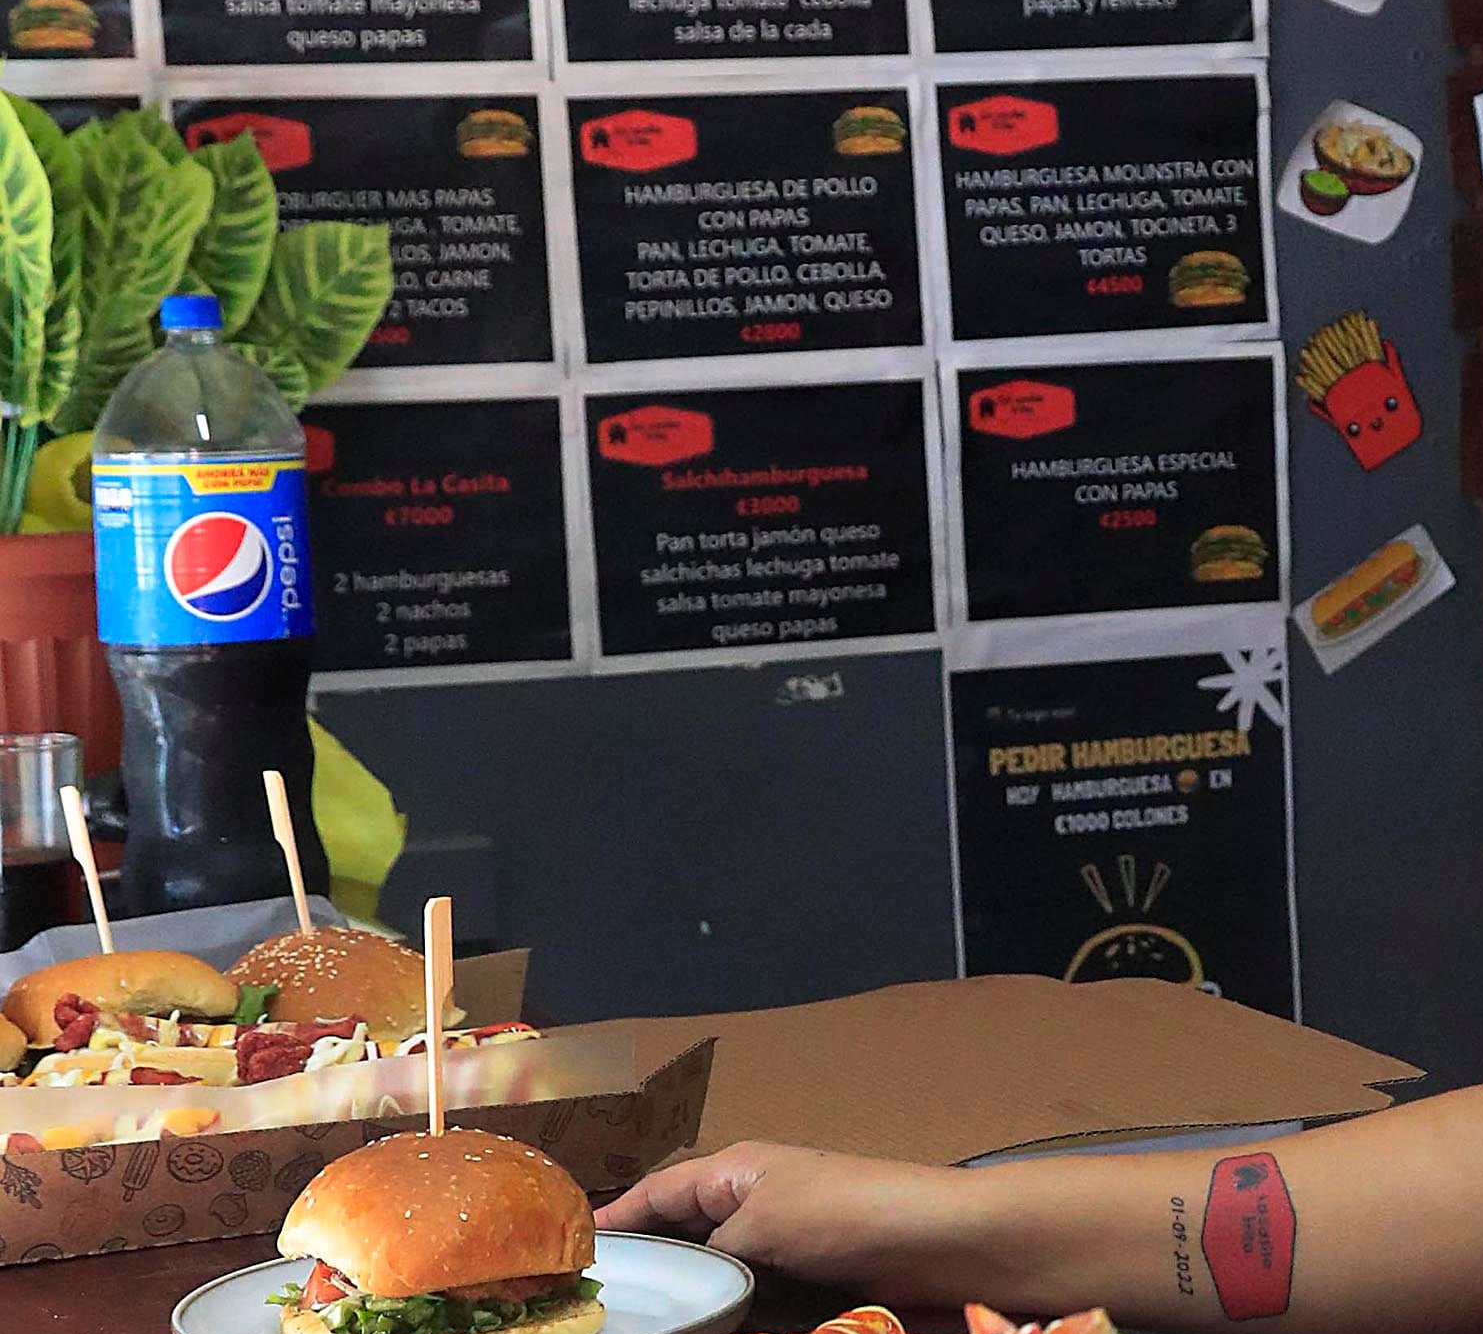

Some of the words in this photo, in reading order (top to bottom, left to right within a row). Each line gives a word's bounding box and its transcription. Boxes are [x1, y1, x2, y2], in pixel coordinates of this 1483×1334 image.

[286, 28, 356, 54] queso
[360, 28, 427, 52] papas
[674, 19, 725, 43] salsa
[728, 19, 757, 43] de
[760, 19, 780, 42] la
[783, 18, 834, 41] cada
[955, 166, 1099, 190] HAMBURGUESA
[1212, 158, 1255, 179] CON
[624, 179, 778, 207] HAMBURGUESA
[782, 178, 808, 201] DE
[812, 176, 878, 199] POLLO
[699, 210, 744, 231] CON
[749, 208, 810, 229] PAPAS
[1077, 245, 1148, 267] TORTAS
[624, 270, 689, 292] TORTA
[694, 268, 721, 289] DE
[823, 288, 893, 313] QUESO
[1011, 454, 1154, 480] HAMBURGUESA
[1157, 451, 1237, 473] ESPECIAL
[1074, 483, 1119, 505] CON
[1122, 480, 1179, 502] PAPAS
[656, 531, 694, 553] Pan
[698, 530, 748, 551] torta
[819, 523, 881, 547] queso
[271, 515, 302, 611] pepsi
[333, 572, 349, 594] 2
[376, 601, 392, 623] 2
[656, 593, 707, 616] salsa
[711, 589, 783, 611] tomate
[787, 583, 887, 608] mayonesa
[711, 619, 774, 643] queso
[383, 633, 399, 655] 2
[989, 742, 1067, 776] PEDIR
[1070, 728, 1250, 768] HAMBURGUESA
